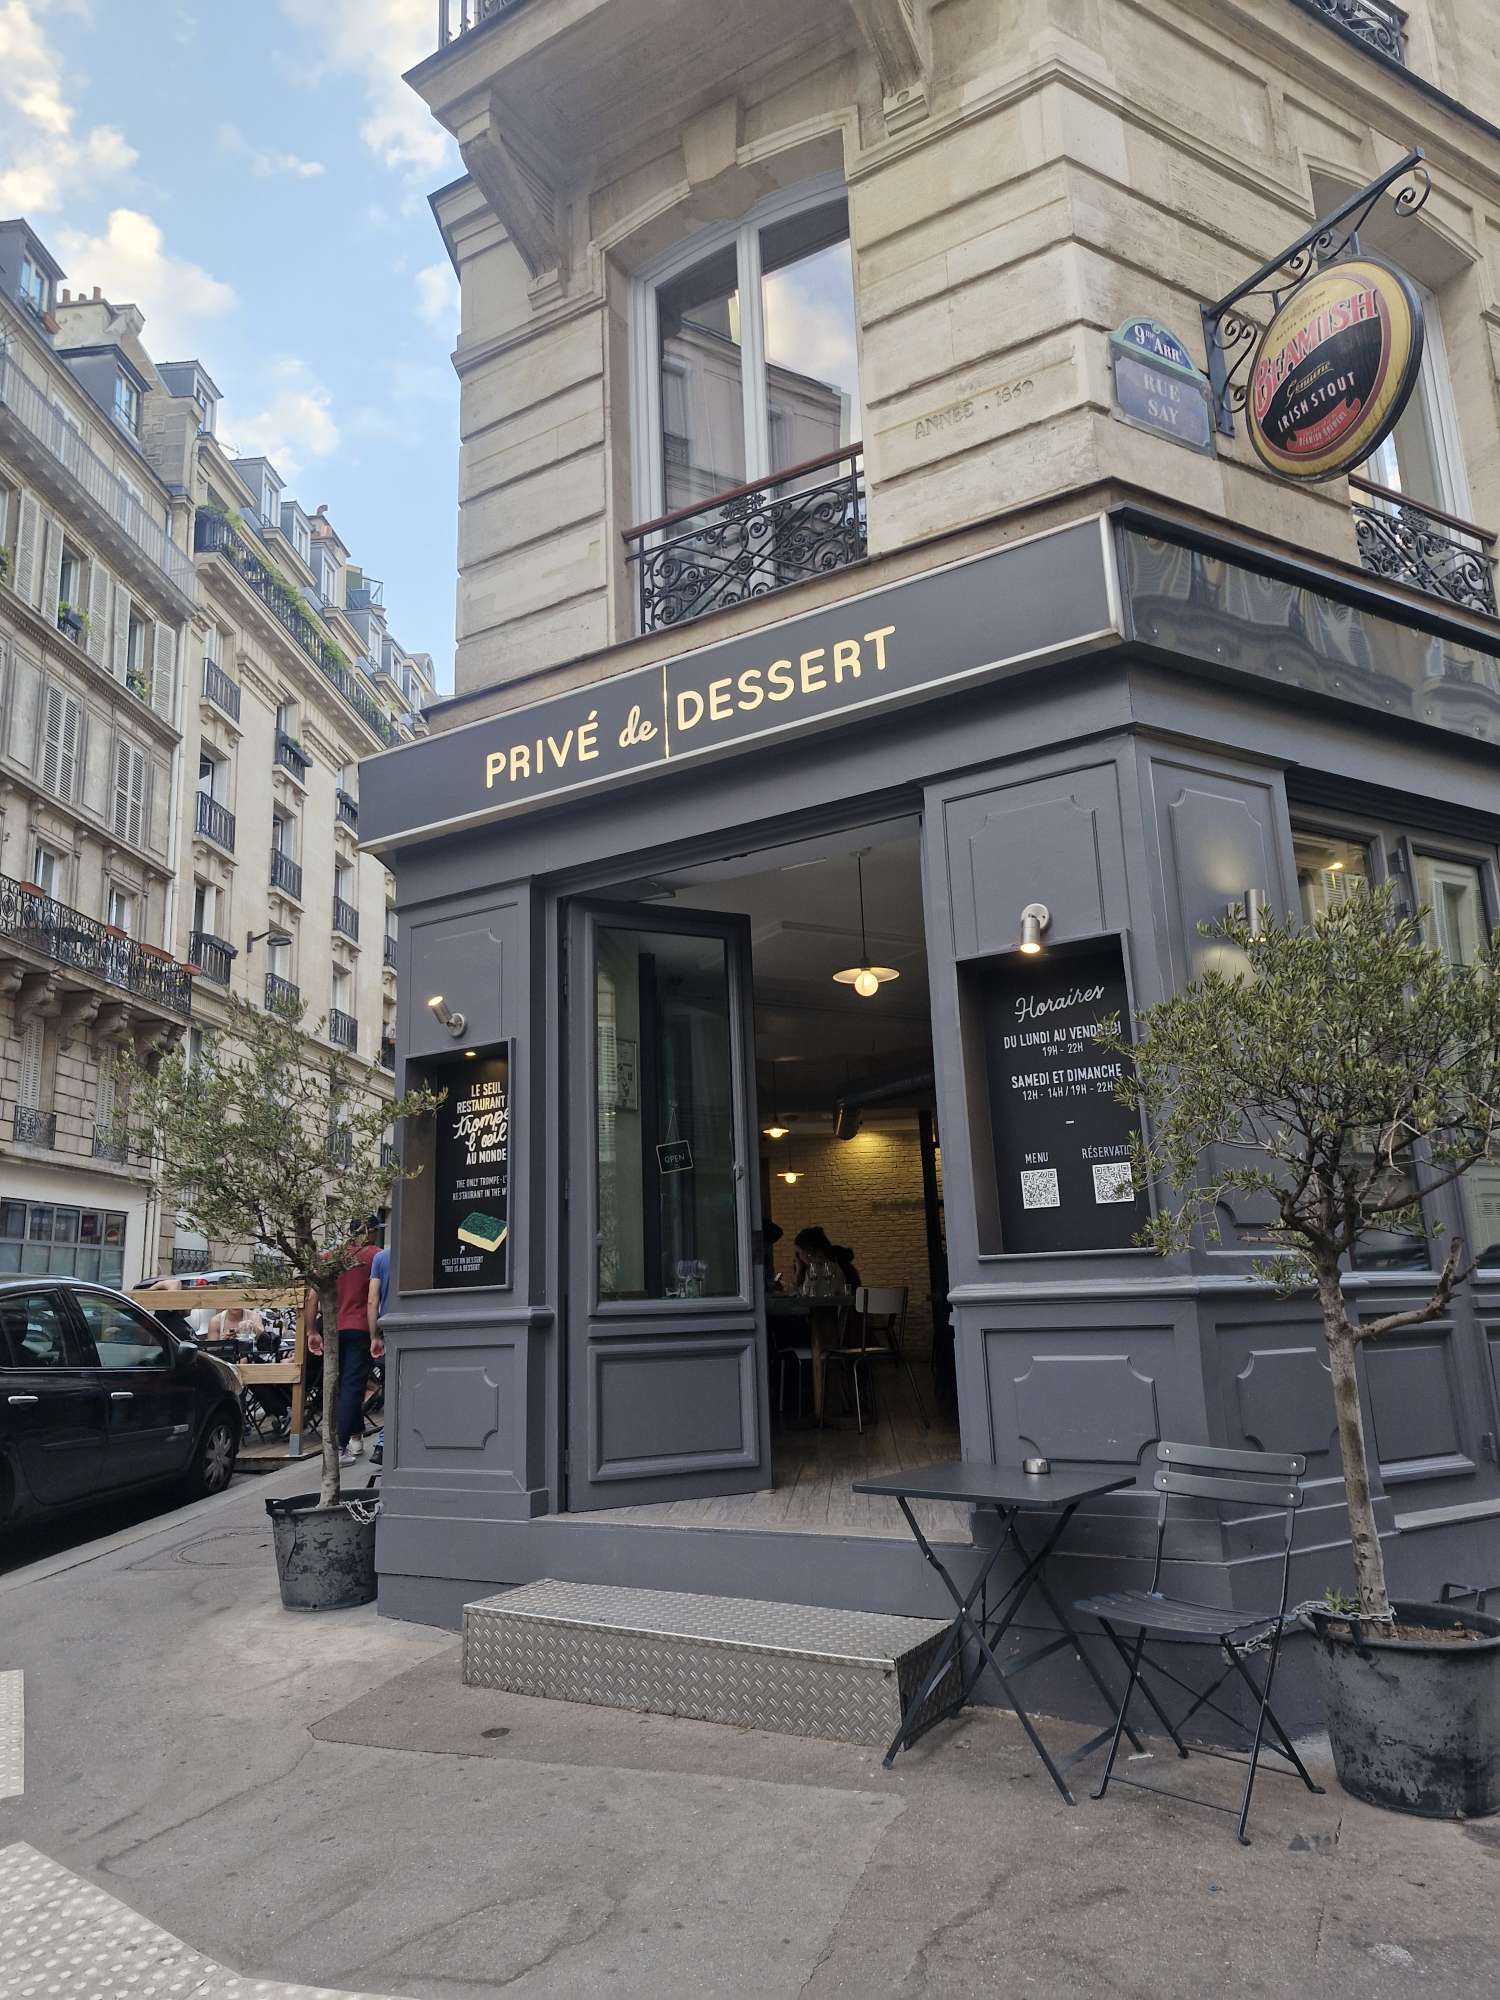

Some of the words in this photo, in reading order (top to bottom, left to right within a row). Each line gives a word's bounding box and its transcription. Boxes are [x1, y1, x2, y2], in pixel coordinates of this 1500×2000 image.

[1254, 288, 1378, 422] BEAMISH
[1143, 373, 1181, 403] RUE
[1286, 361, 1333, 403] Genuine
[1147, 400, 1179, 426] SAY
[1277, 399, 1309, 433] IRISH
[1310, 371, 1356, 407] STOUT
[485, 709, 600, 789] PRIVÉ
[618, 705, 659, 749] de
[676, 625, 897, 732] DESSERT
[1014, 985, 1105, 1023] Horaires
[1004, 1034, 1017, 1049] DU
[1019, 1030, 1050, 1047] LUNDI
[1053, 1027, 1067, 1042] AU
[1042, 1045, 1058, 1057] 19H
[1067, 1042, 1084, 1054] 22H
[1011, 1071, 1050, 1089] SAMEDI
[1053, 1070, 1065, 1083] ET
[1067, 1063, 1123, 1081] DIMANCHE
[471, 1083, 481, 1098] LE
[482, 1081, 503, 1096] SEUL
[1022, 1090, 1038, 1101] 12H
[1047, 1087, 1063, 1099] 14H
[1071, 1084, 1087, 1096] 19H
[1096, 1083, 1113, 1095] 22H
[456, 1095, 506, 1114] RESTAURANT
[452, 1107, 509, 1139] trompe
[466, 1151, 477, 1166] AU
[478, 1147, 507, 1164] MONDE
[1025, 1151, 1049, 1165] MENU
[1081, 1144, 1134, 1160] RÉSERVATIO
[453, 1189, 484, 1201] RESTAURANT
[485, 1189, 491, 1198] IN
[491, 1188, 501, 1197] THE
[456, 1179, 466, 1190] THE
